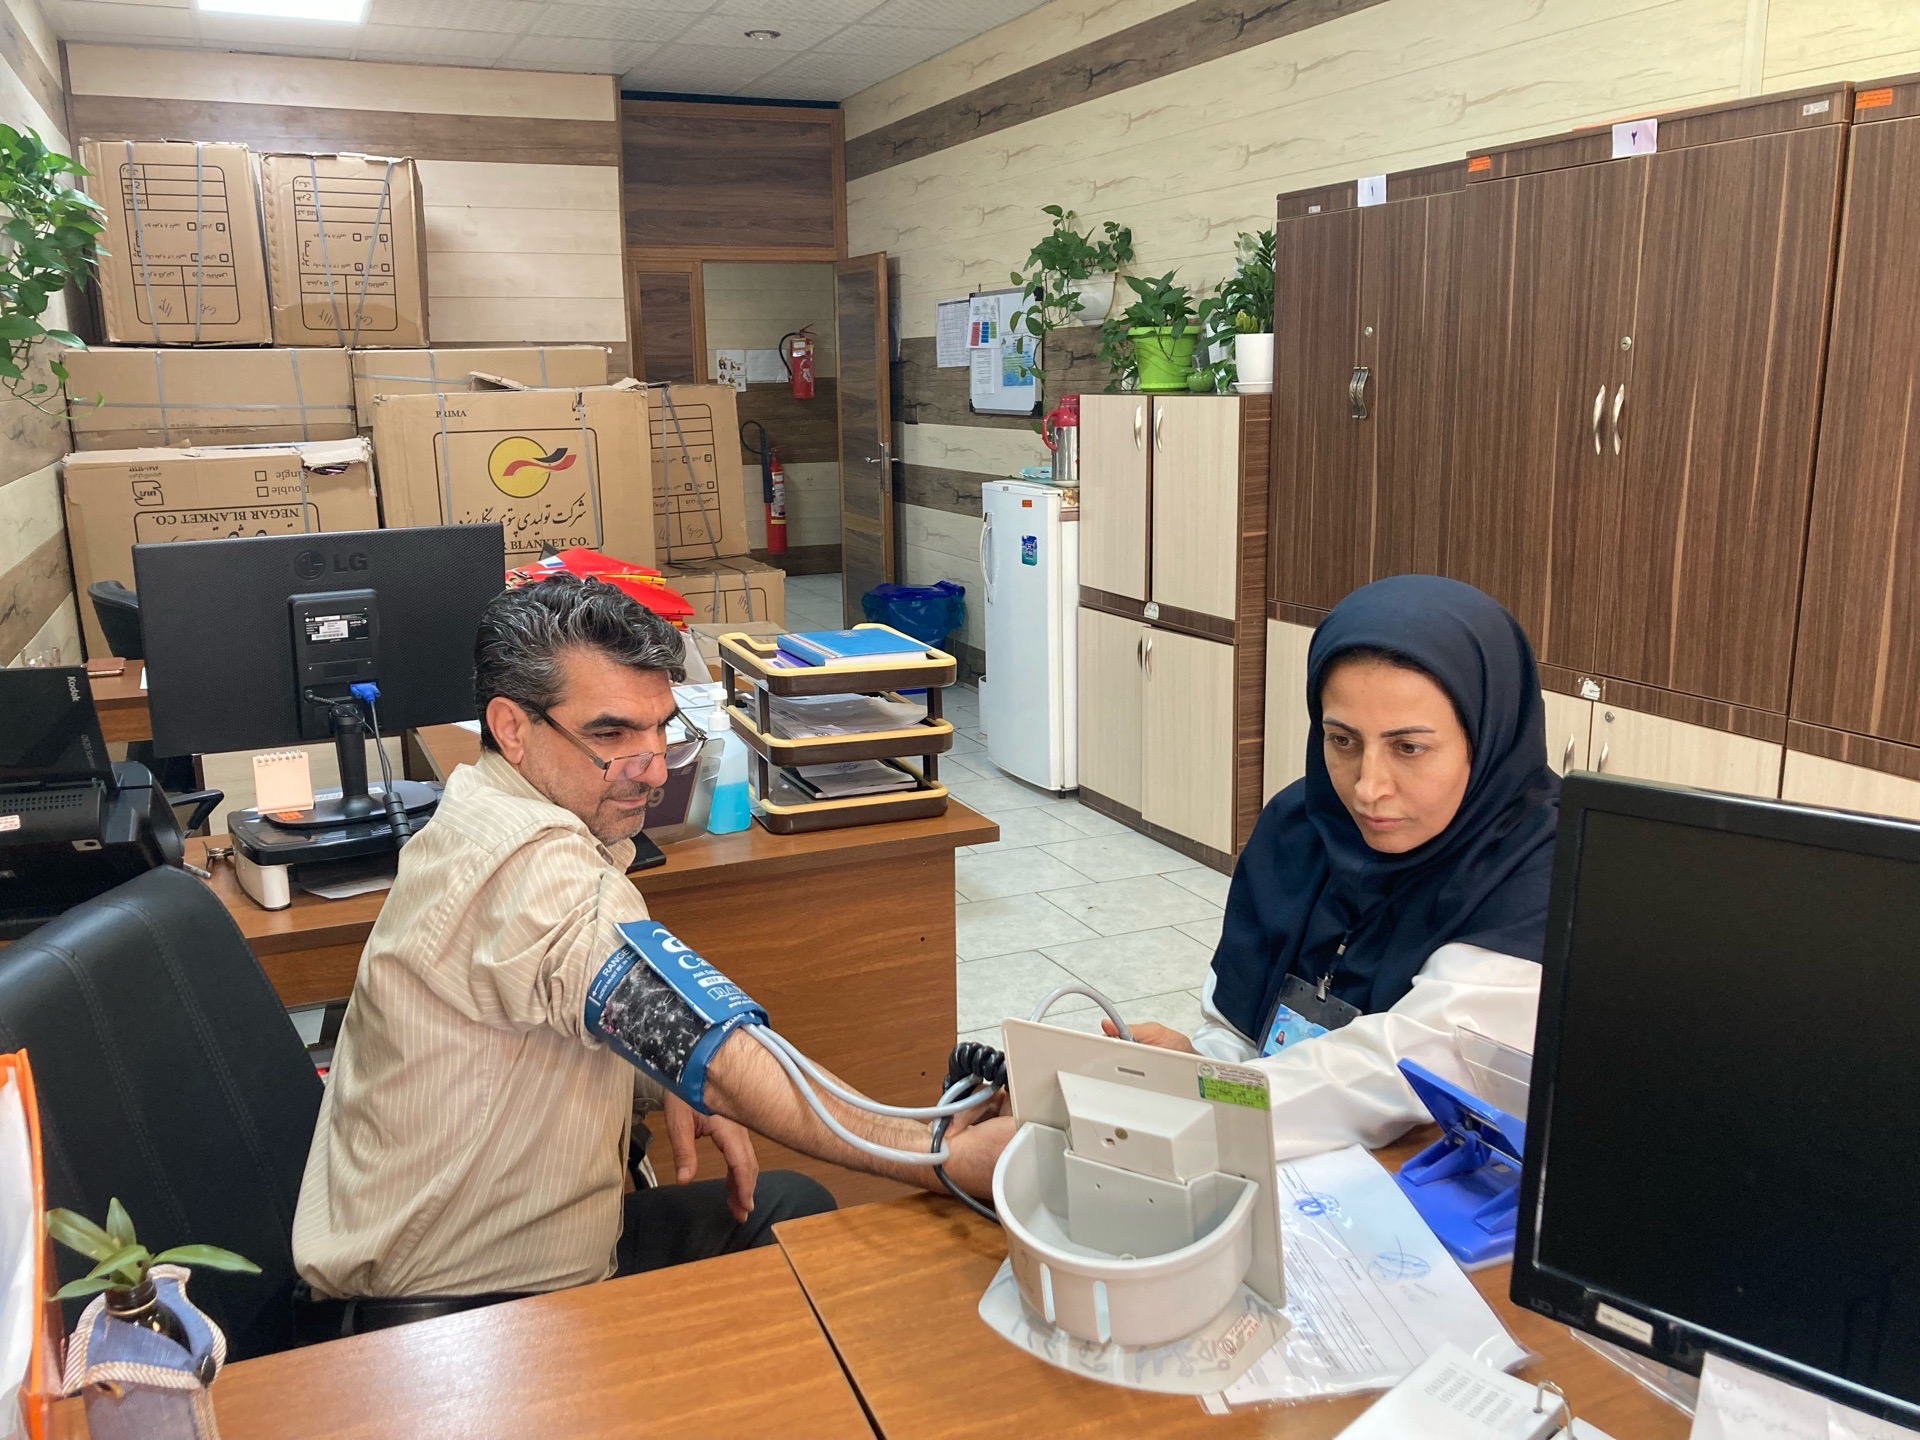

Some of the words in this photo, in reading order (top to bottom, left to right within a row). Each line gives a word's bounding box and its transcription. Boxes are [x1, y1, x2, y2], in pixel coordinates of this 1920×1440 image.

[152, 514, 177, 526] CO.
[180, 511, 247, 525] BLANKET
[250, 508, 299, 519] NEGAR
[517, 503, 552, 536] تولیدی
[552, 491, 587, 528] شرکت
[510, 537, 567, 551] BLANKET
[568, 536, 590, 547] CO.
[331, 553, 368, 574] LG
[67, 676, 82, 702] Kodak
[602, 948, 631, 977] RANGE
